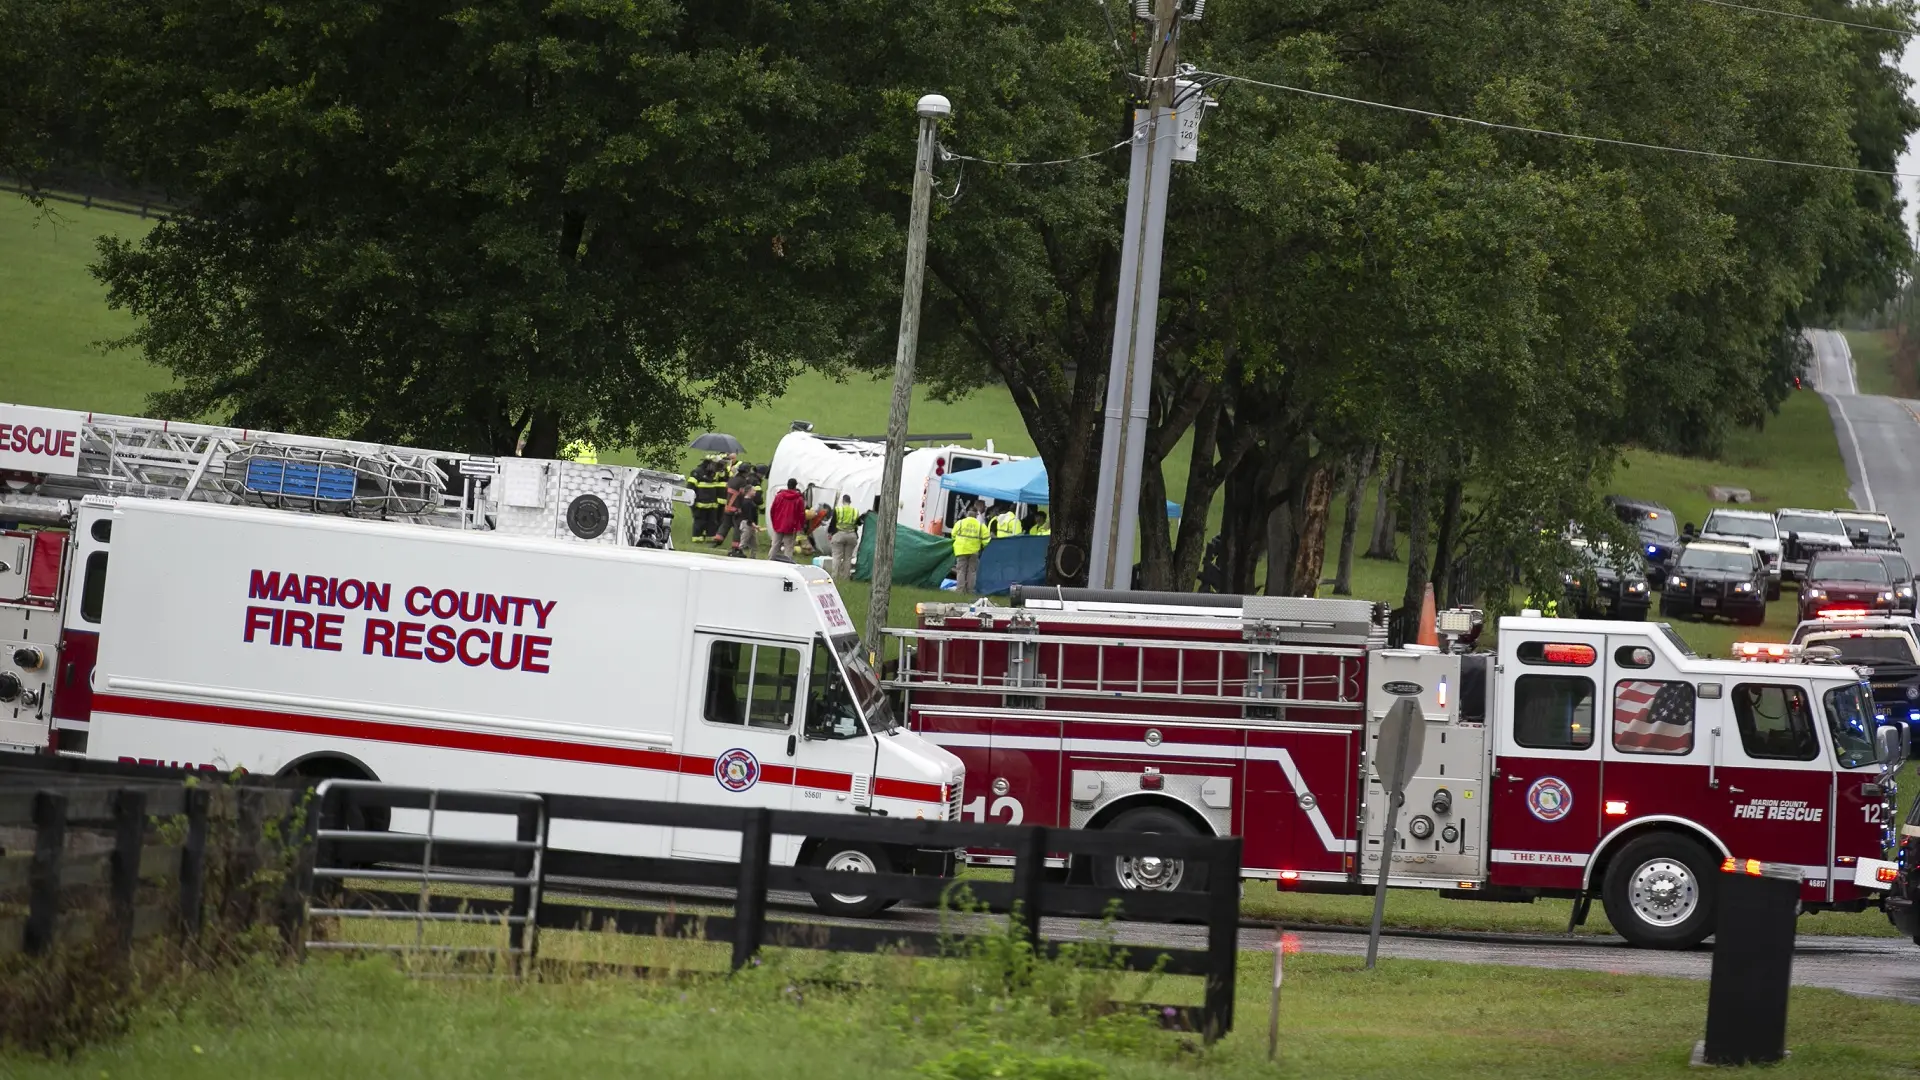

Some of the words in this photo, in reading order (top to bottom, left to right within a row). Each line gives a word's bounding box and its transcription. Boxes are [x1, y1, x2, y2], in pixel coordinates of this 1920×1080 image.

[248, 569, 392, 612] MARION
[405, 586, 557, 629] COUNTY
[243, 606, 345, 651] FIRE
[362, 618, 553, 673] RESCUE
[804, 790, 822, 800] 55601
[1750, 799, 1779, 807] MARION
[1780, 800, 1808, 808] COUNTY
[1734, 805, 1764, 819] FIRE
[1767, 806, 1823, 822] RESCUE
[1860, 803, 1881, 823] 12
[1510, 852, 1536, 861] THE
[1539, 853, 1573, 863] FARM
[1809, 879, 1826, 887] 46817
